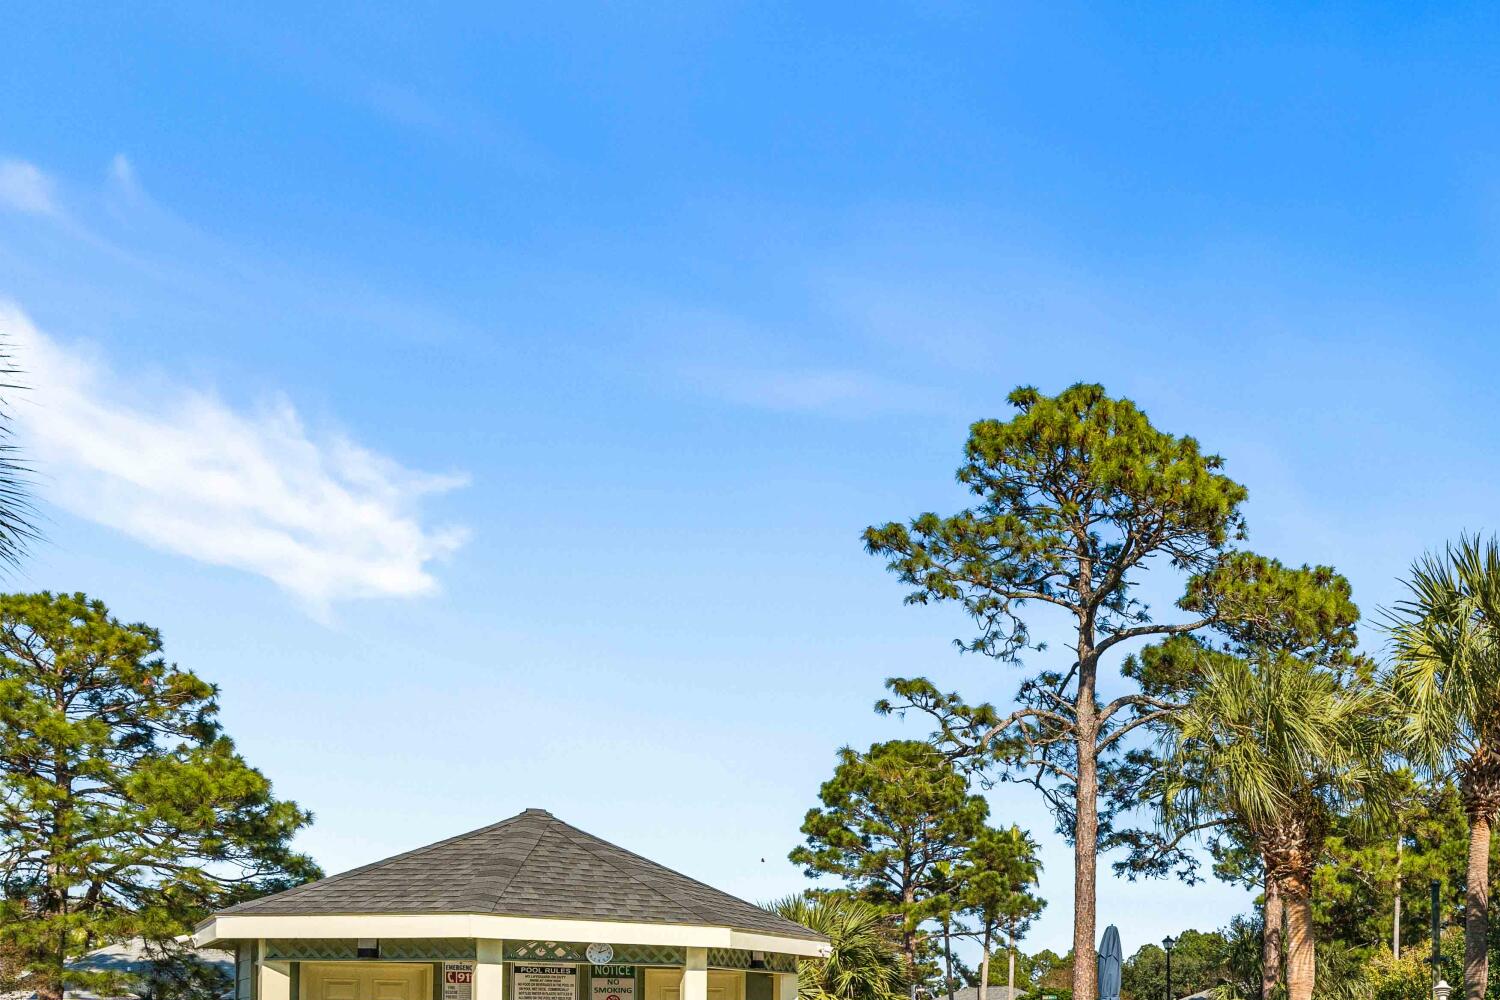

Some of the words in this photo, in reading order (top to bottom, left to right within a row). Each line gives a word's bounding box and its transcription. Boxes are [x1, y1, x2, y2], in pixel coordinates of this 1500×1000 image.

[520, 966, 543, 974] POOL
[544, 967, 571, 975] RULES
[594, 965, 631, 976] NOTICE
[457, 972, 472, 982] 91
